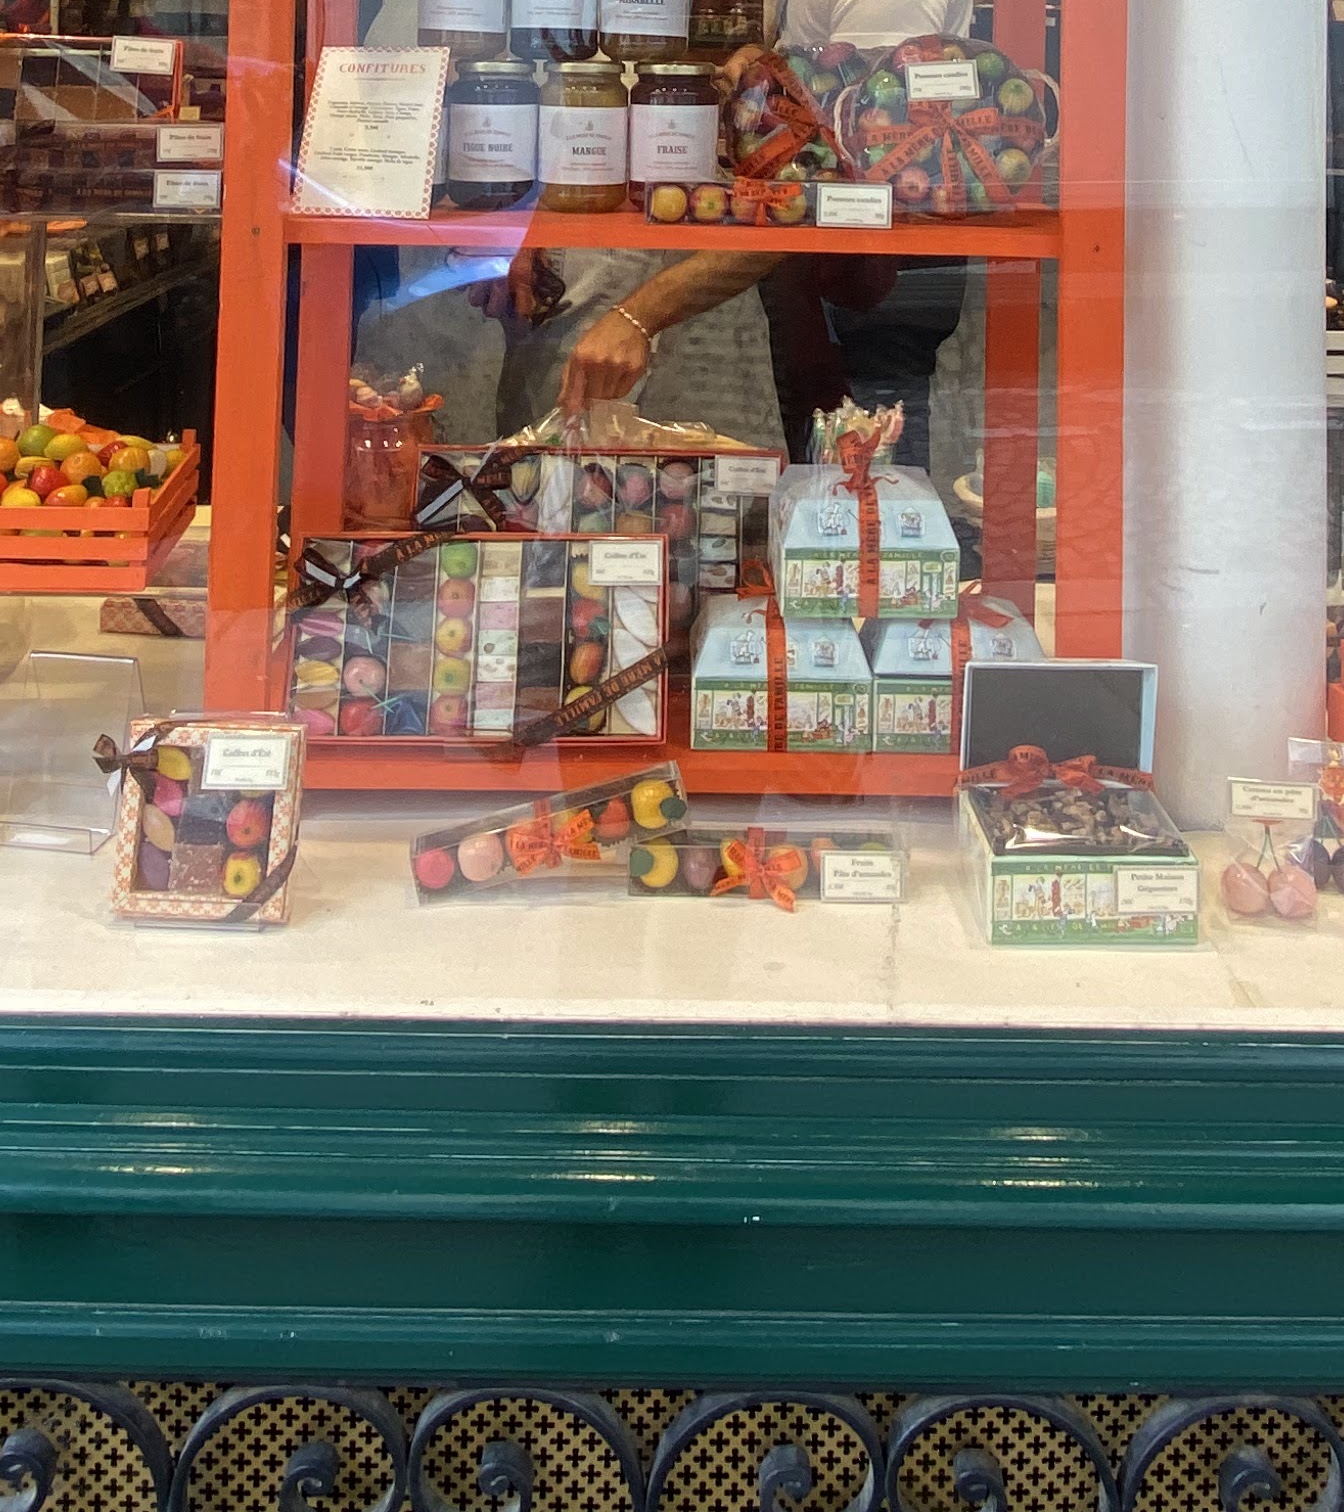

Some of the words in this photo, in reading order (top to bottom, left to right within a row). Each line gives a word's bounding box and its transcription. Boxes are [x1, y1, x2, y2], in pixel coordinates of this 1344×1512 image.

[339, 63, 427, 75] CONFITURES
[463, 143, 485, 153] FIGUE
[488, 143, 513, 153] NOIRE
[572, 146, 607, 157] MANGUE
[657, 145, 688, 156] FRAISE
